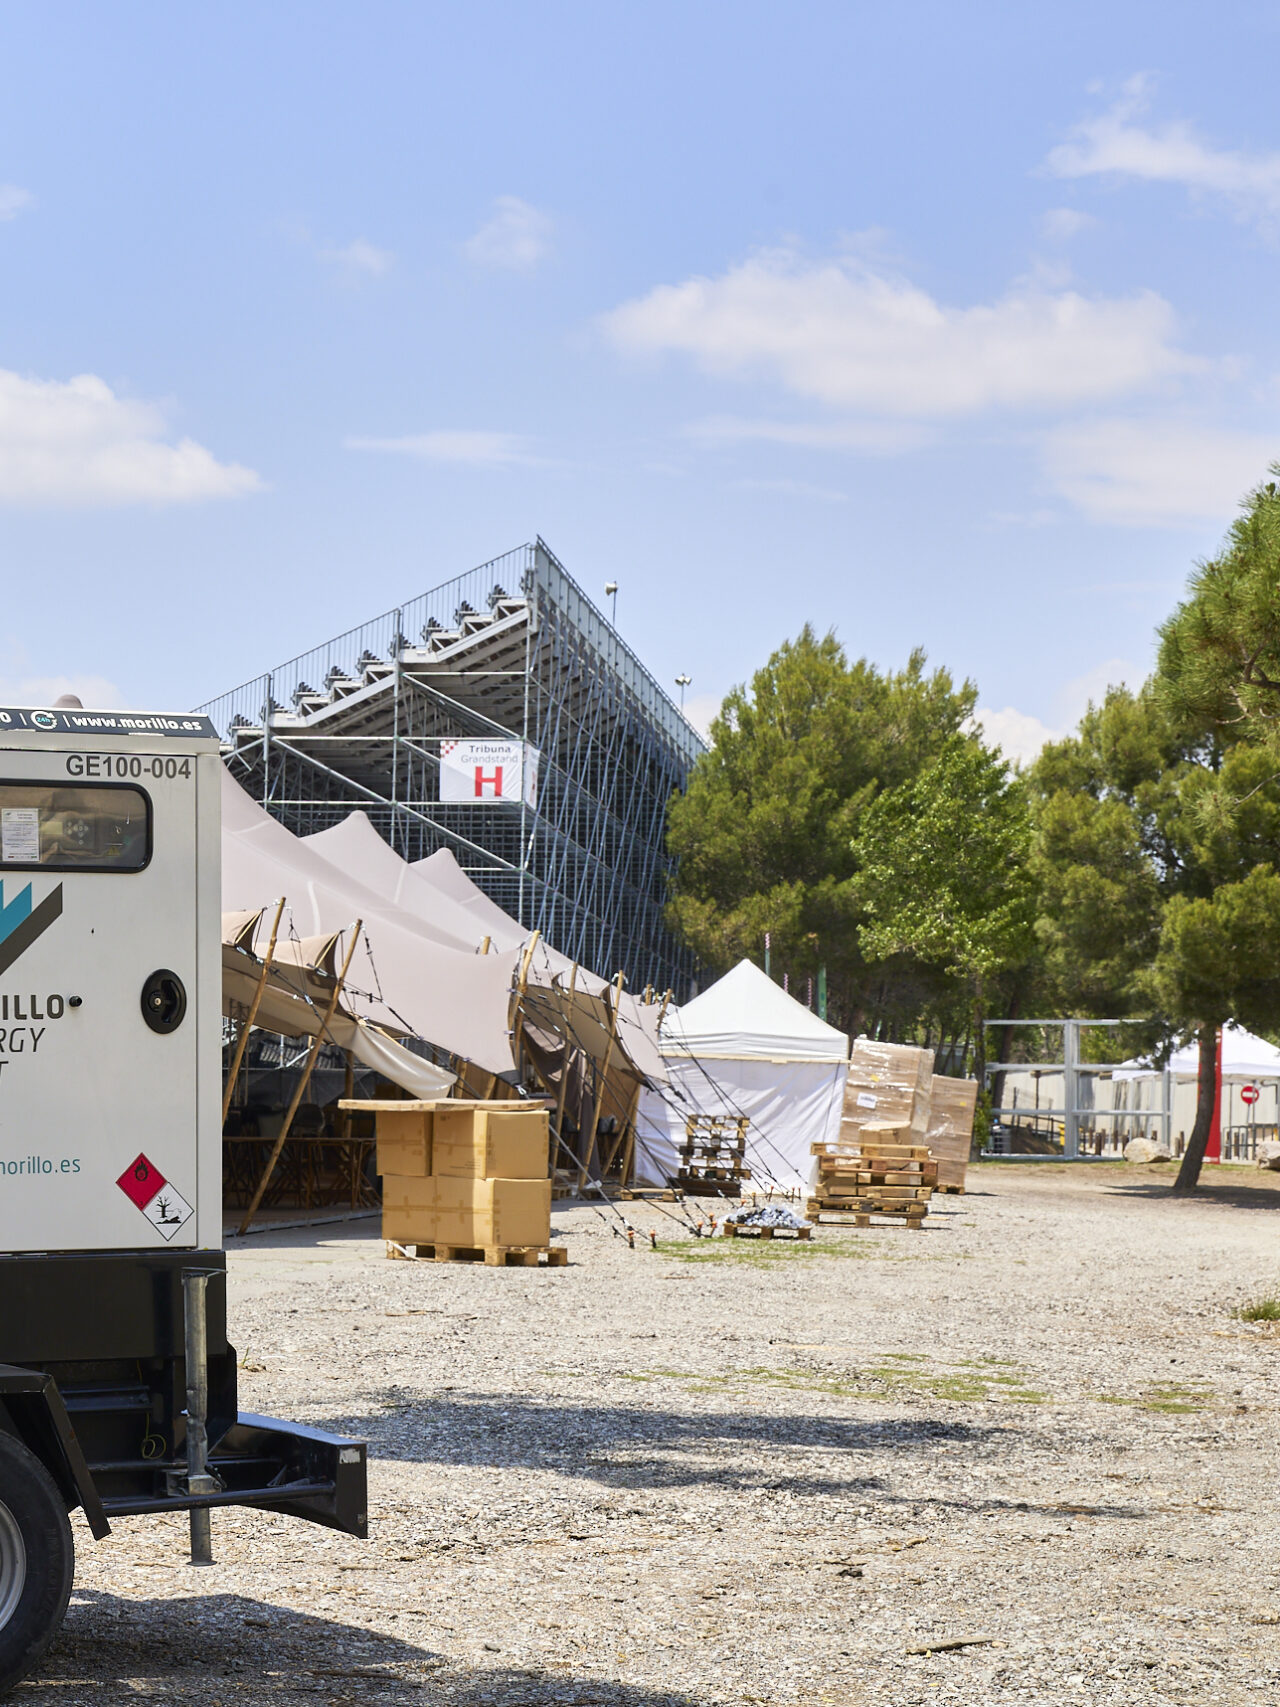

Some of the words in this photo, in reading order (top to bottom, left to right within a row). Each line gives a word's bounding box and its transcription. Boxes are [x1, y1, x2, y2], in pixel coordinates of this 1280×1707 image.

[71, 715, 203, 731] www.morillo.es
[468, 745, 511, 754] Tribuna
[66, 754, 192, 779] GE100-004
[460, 754, 518, 764] Grandstand
[474, 766, 503, 797] H
